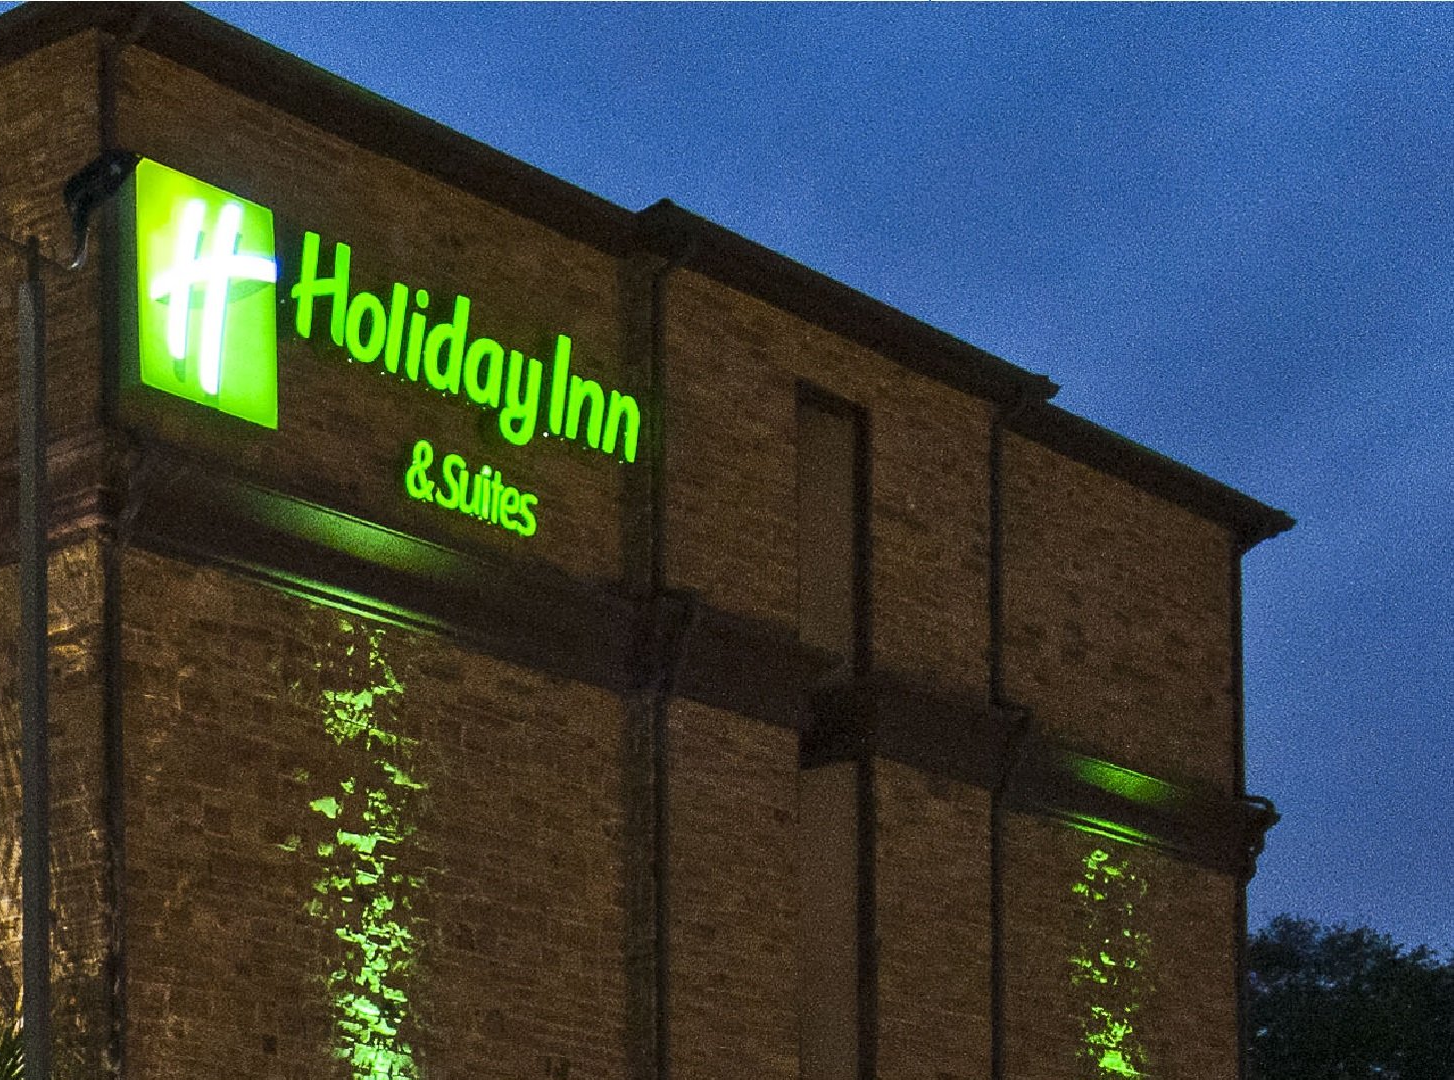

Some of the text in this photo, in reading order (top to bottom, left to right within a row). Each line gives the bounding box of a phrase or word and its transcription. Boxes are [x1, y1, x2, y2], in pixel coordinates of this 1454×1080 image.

[291, 231, 641, 463] Holiday Inn
[404, 439, 539, 537] & Suites
